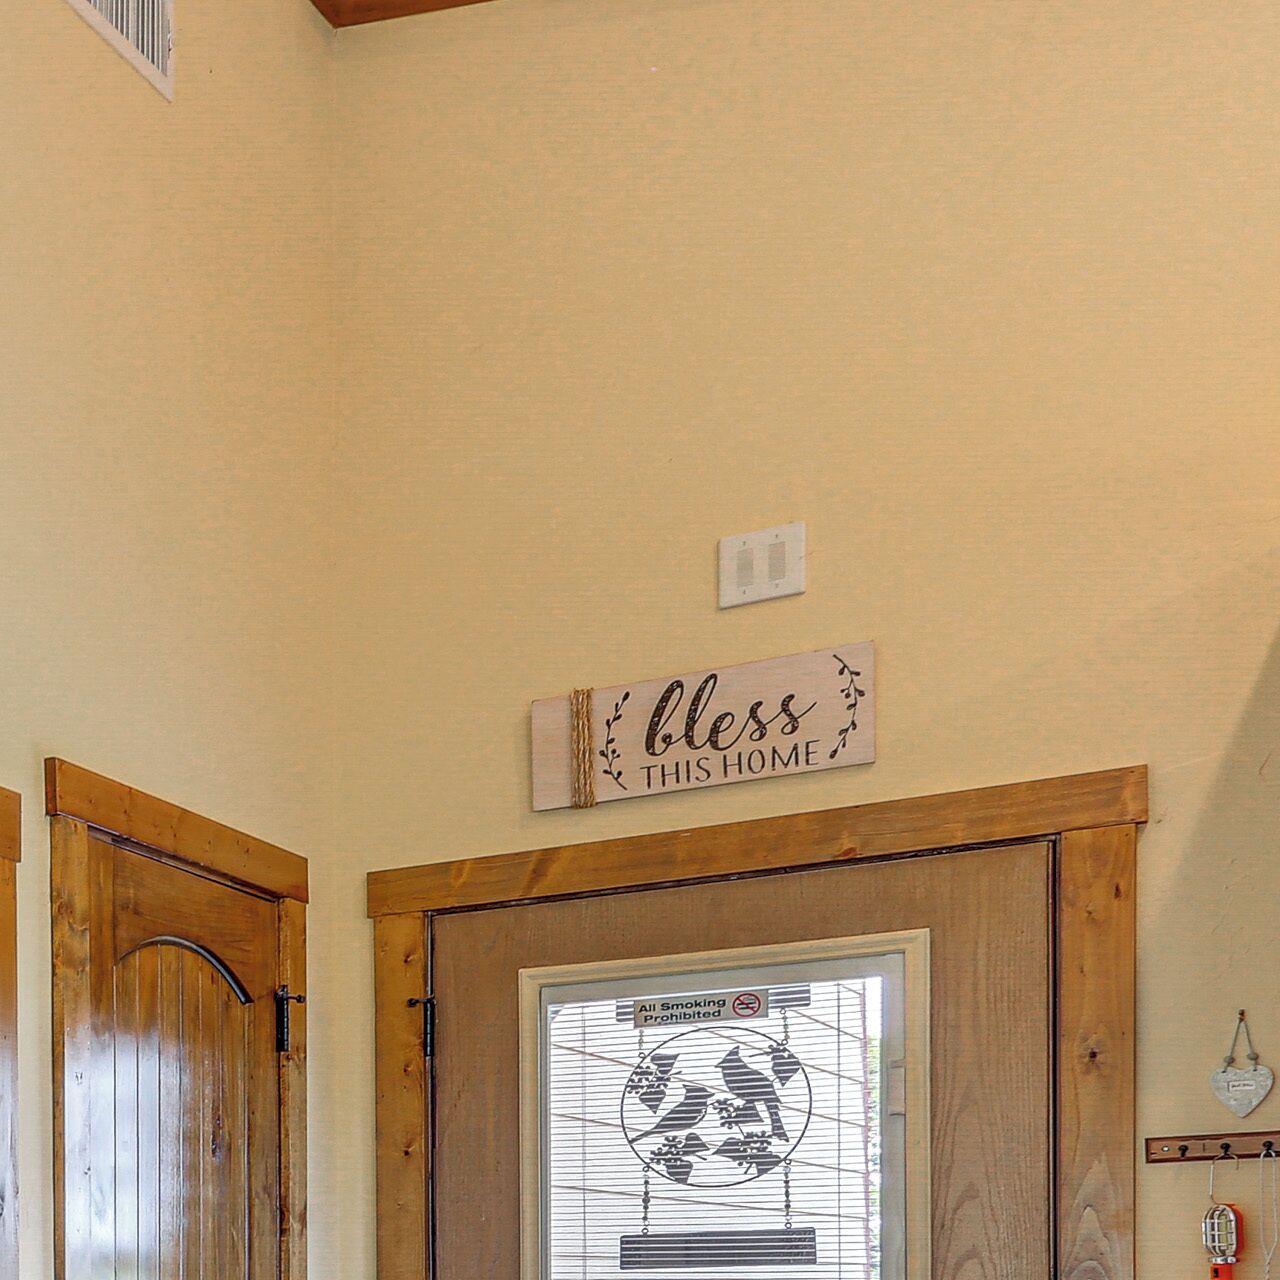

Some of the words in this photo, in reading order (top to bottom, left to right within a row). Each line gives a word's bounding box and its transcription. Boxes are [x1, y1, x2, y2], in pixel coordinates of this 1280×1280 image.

[644, 673, 818, 757] bless
[640, 756, 712, 789] THIS
[723, 739, 821, 777] HOME
[638, 1003, 656, 1013] All
[660, 999, 727, 1011] Smoking
[643, 1009, 722, 1023] Prohibited
